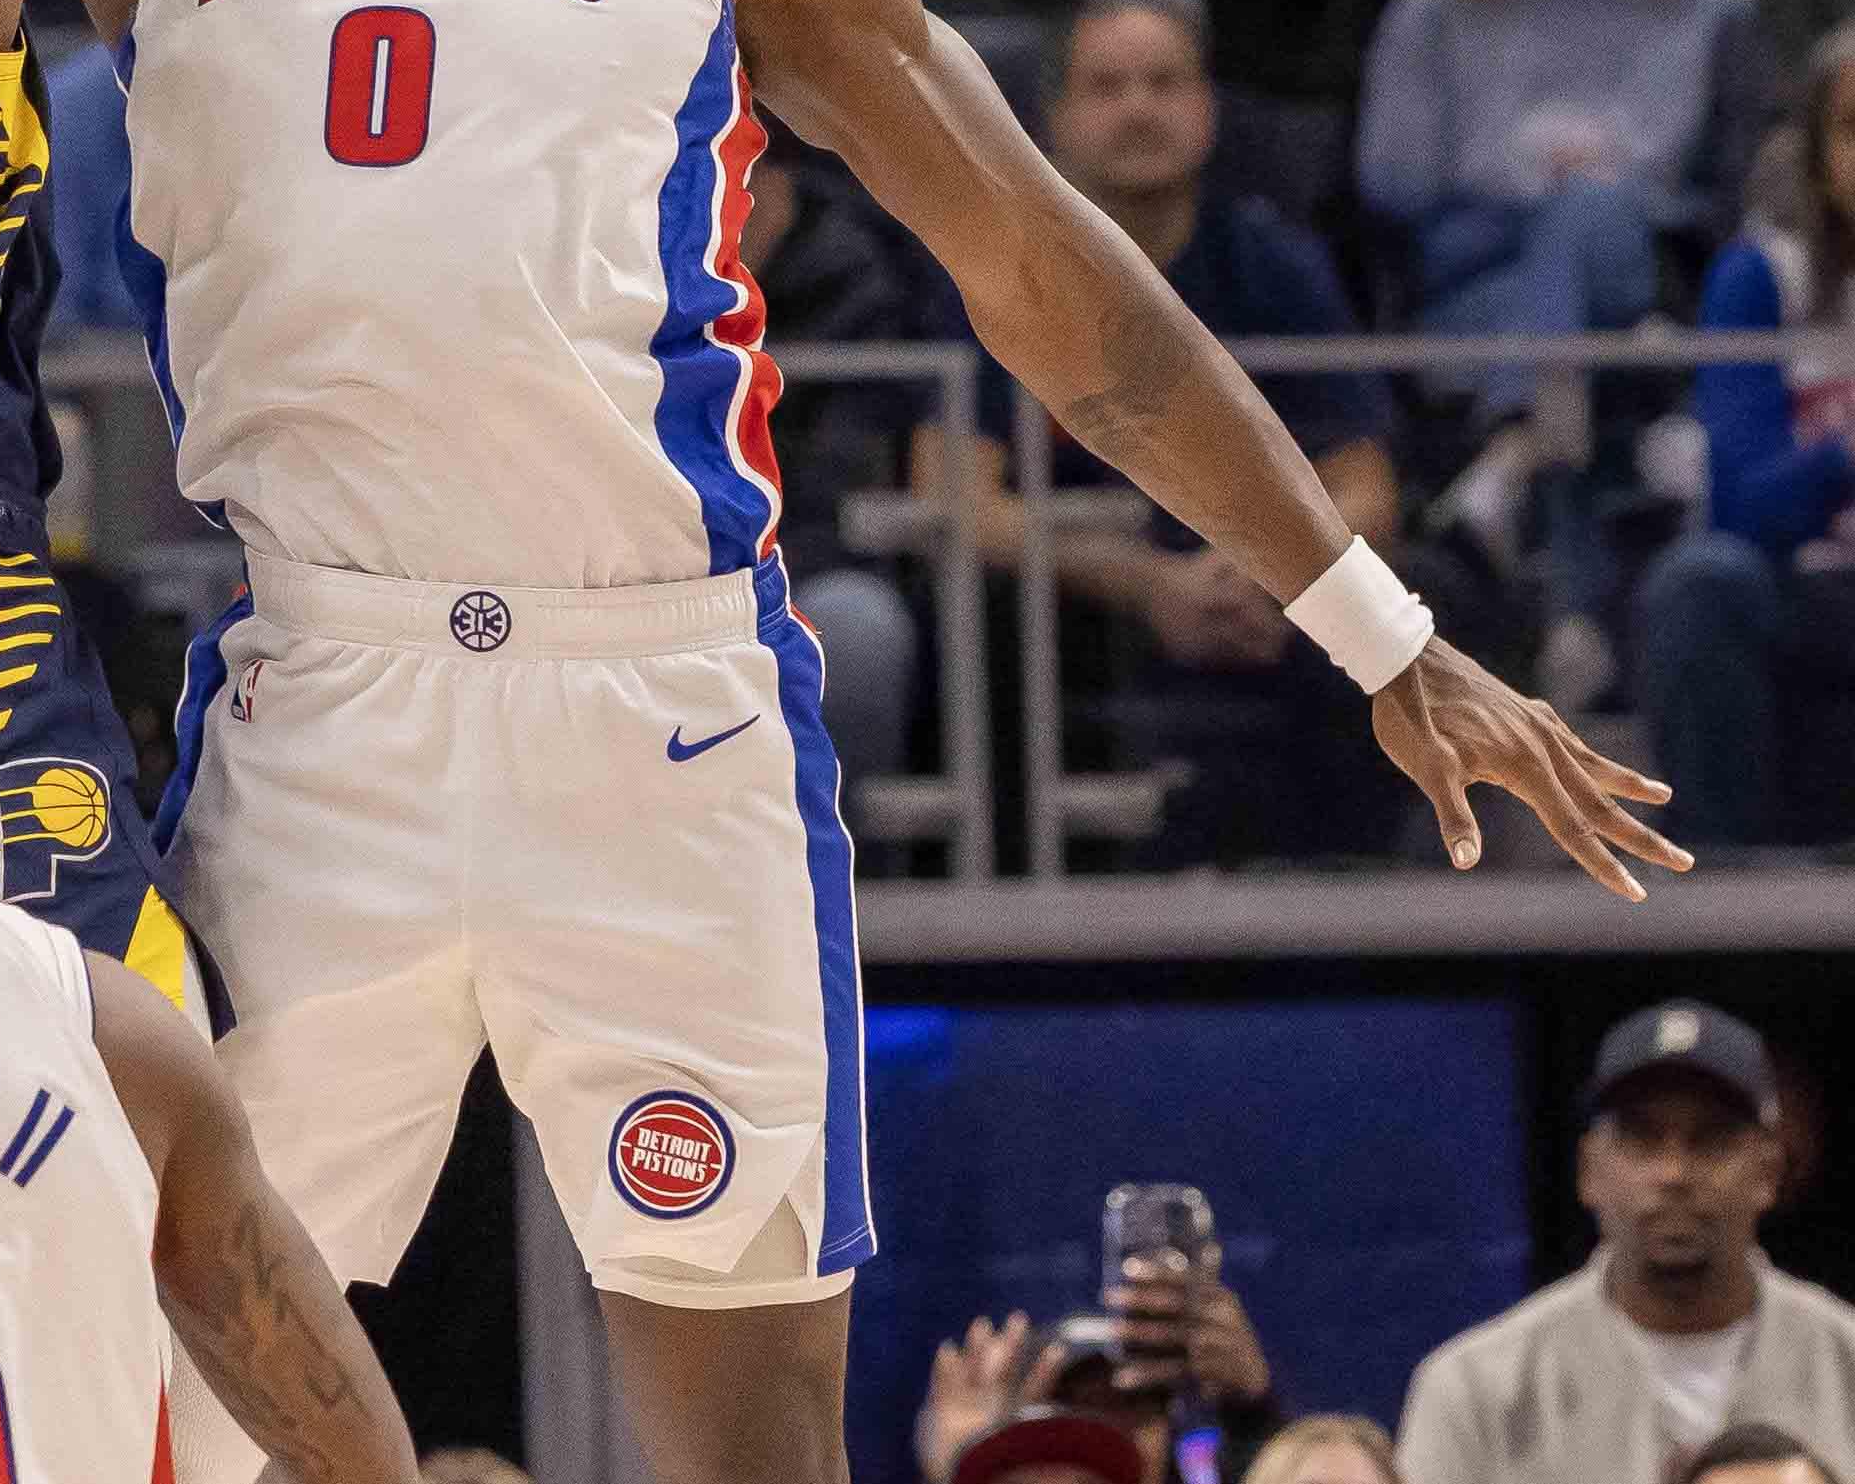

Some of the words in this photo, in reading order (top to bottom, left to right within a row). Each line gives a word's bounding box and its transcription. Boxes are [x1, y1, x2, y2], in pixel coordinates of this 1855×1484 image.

[324, 5, 436, 168] 0
[637, 1127, 712, 1163] DETROIT
[631, 1146, 709, 1184] PISTONS
